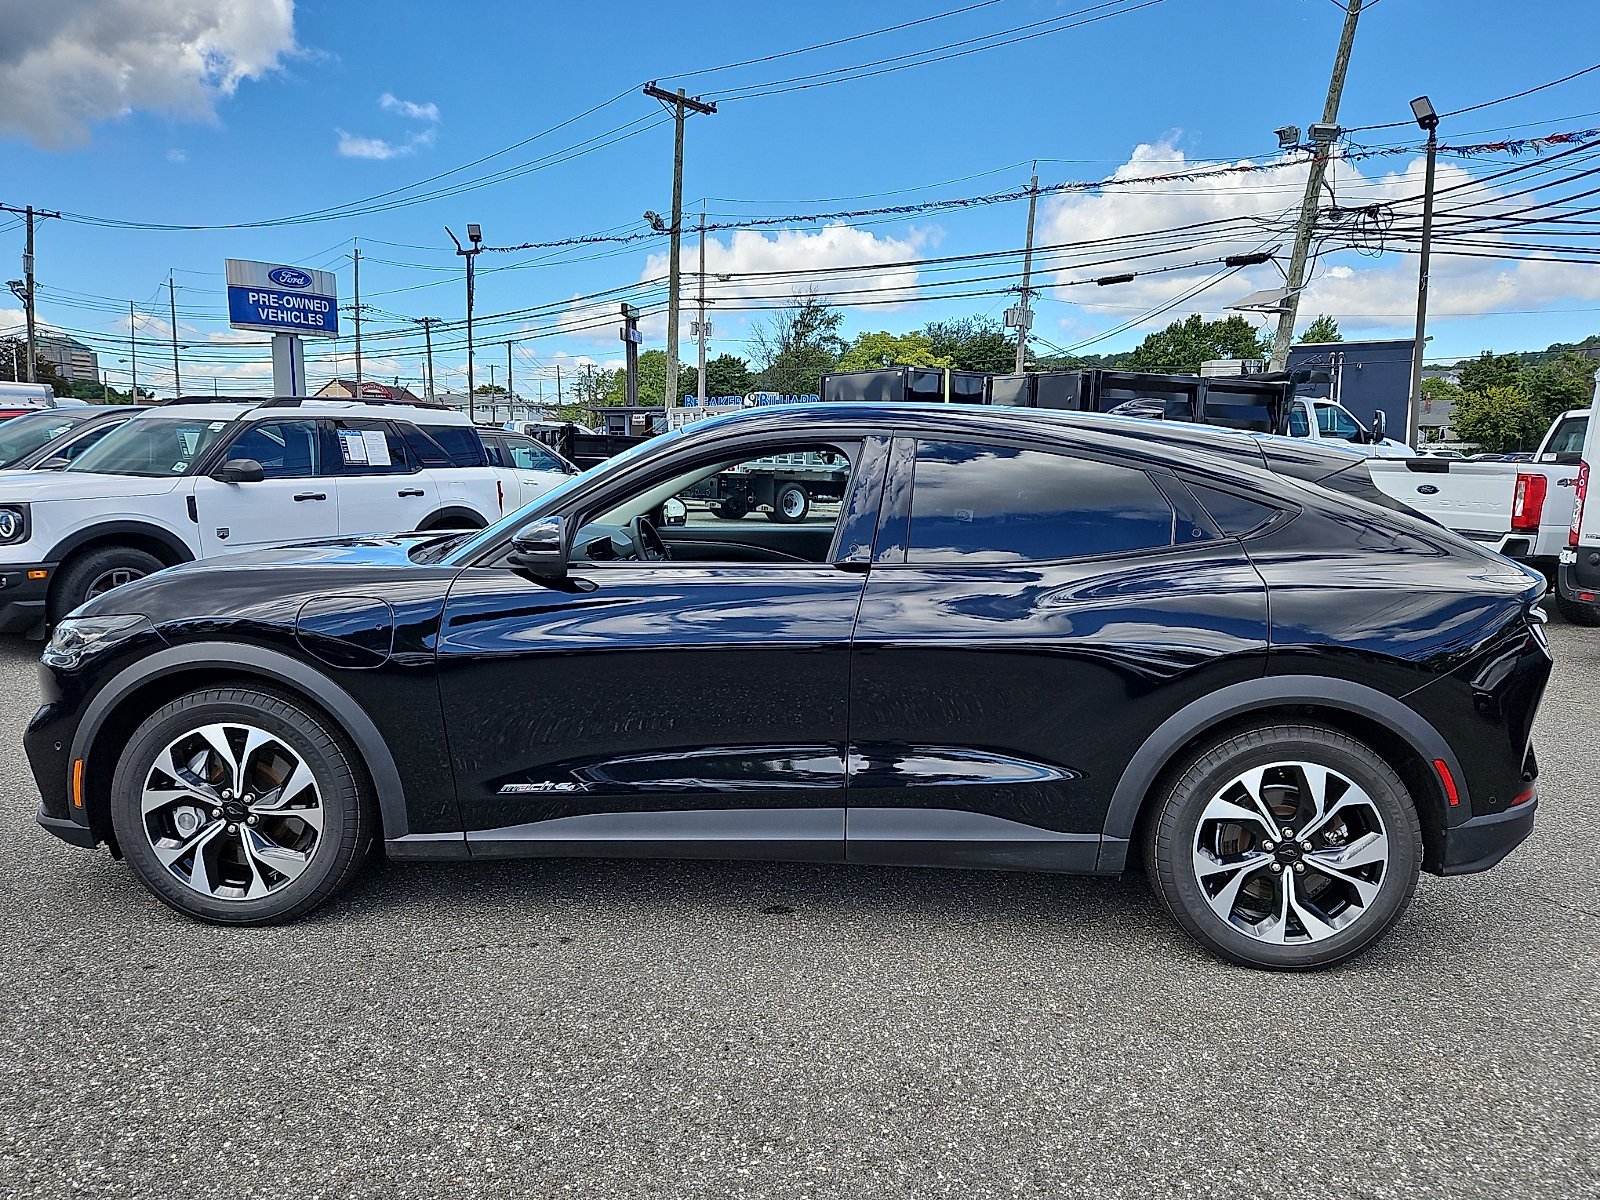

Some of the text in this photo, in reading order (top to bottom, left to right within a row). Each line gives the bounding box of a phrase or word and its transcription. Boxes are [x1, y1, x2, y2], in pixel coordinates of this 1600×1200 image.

[279, 270, 305, 286] Ford
[248, 291, 330, 313] PRE-OWNED
[258, 307, 325, 327] VEHICLES
